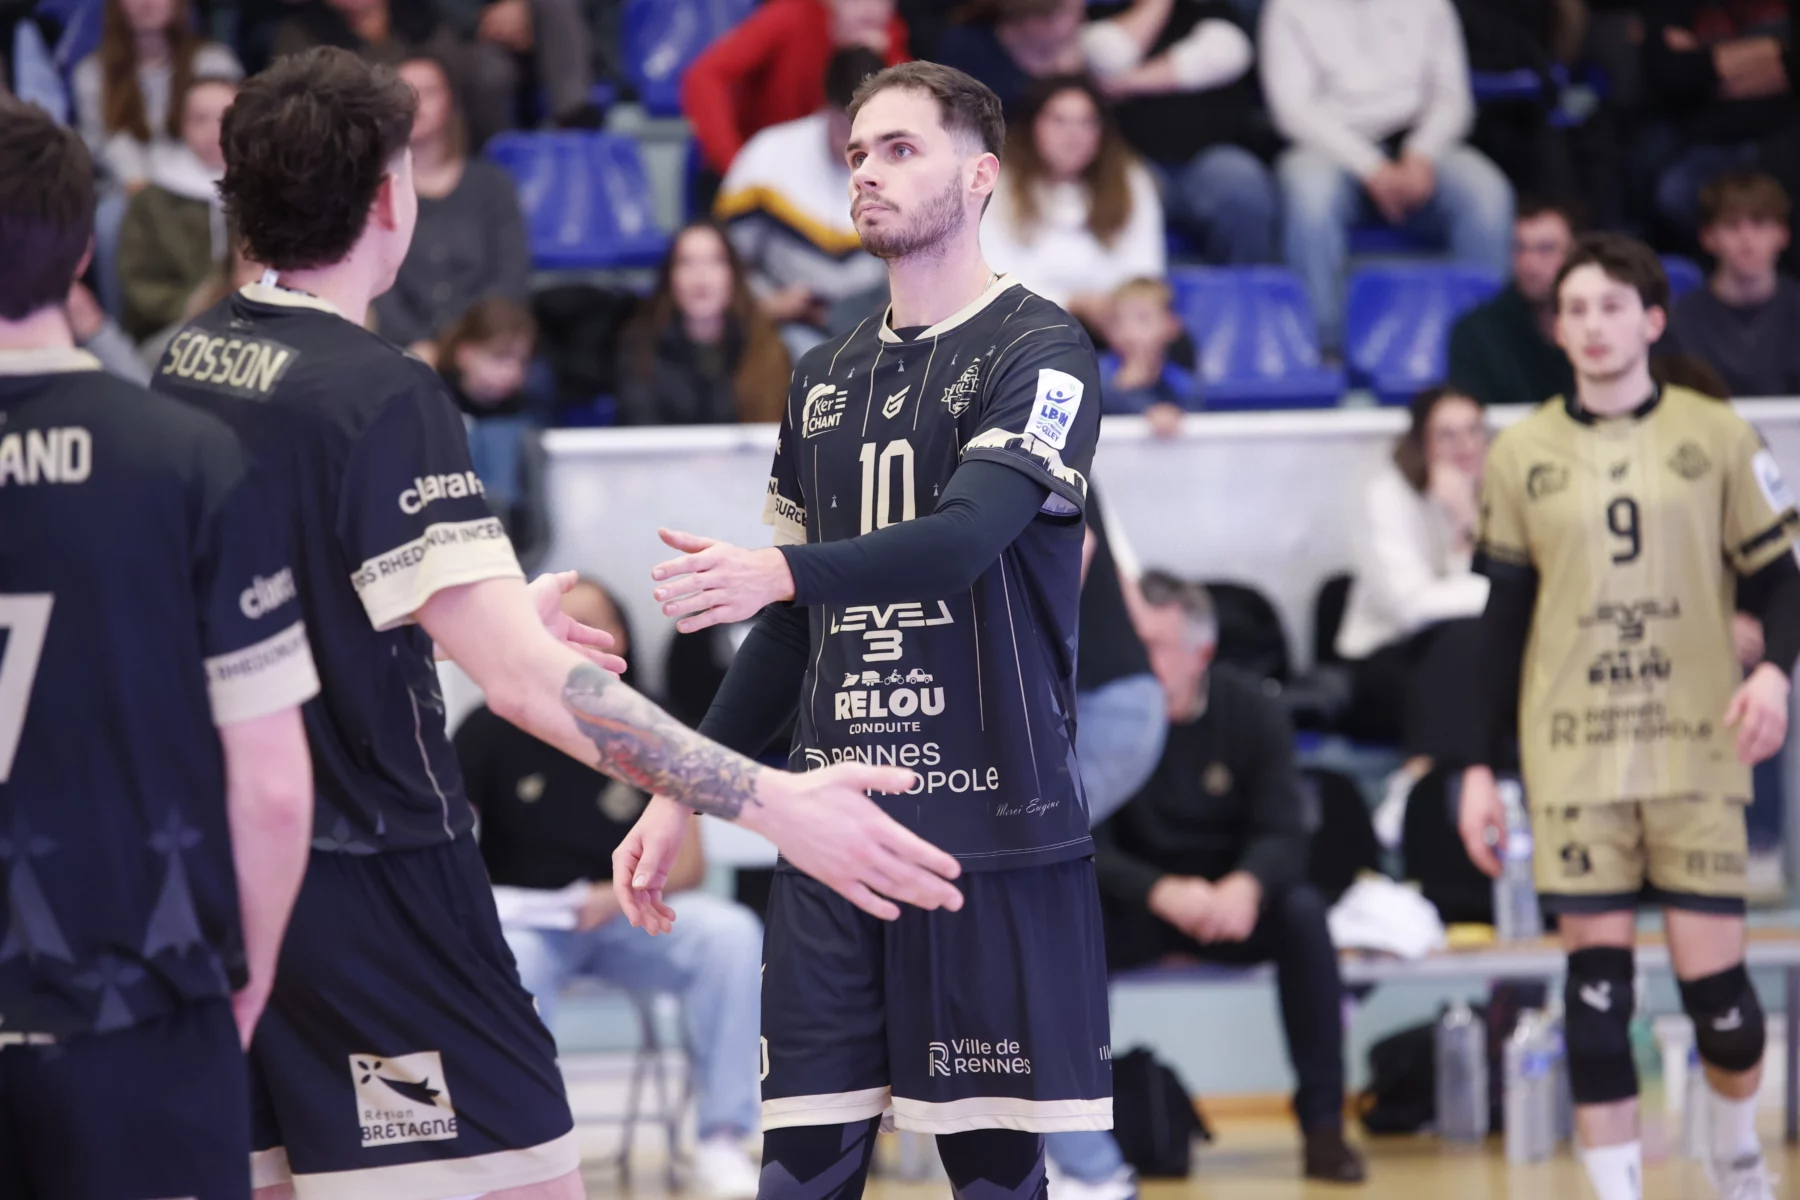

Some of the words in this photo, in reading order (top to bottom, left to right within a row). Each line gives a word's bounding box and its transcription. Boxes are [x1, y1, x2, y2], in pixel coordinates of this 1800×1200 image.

[162, 332, 289, 392] SOSSON
[808, 412, 843, 432] CHANT
[812, 397, 834, 416] Ker
[0, 427, 92, 486] AND
[859, 438, 915, 536] 10
[1608, 497, 1641, 566] 9
[830, 600, 955, 634] LEVEL
[862, 629, 903, 663] 3
[835, 687, 946, 720] RELOU
[849, 721, 921, 734] CONDUITE
[951, 1039, 991, 1055] Ville
[996, 1039, 1020, 1055] de
[361, 1117, 458, 1141] BRETAGNE
[364, 1109, 414, 1122] Région
